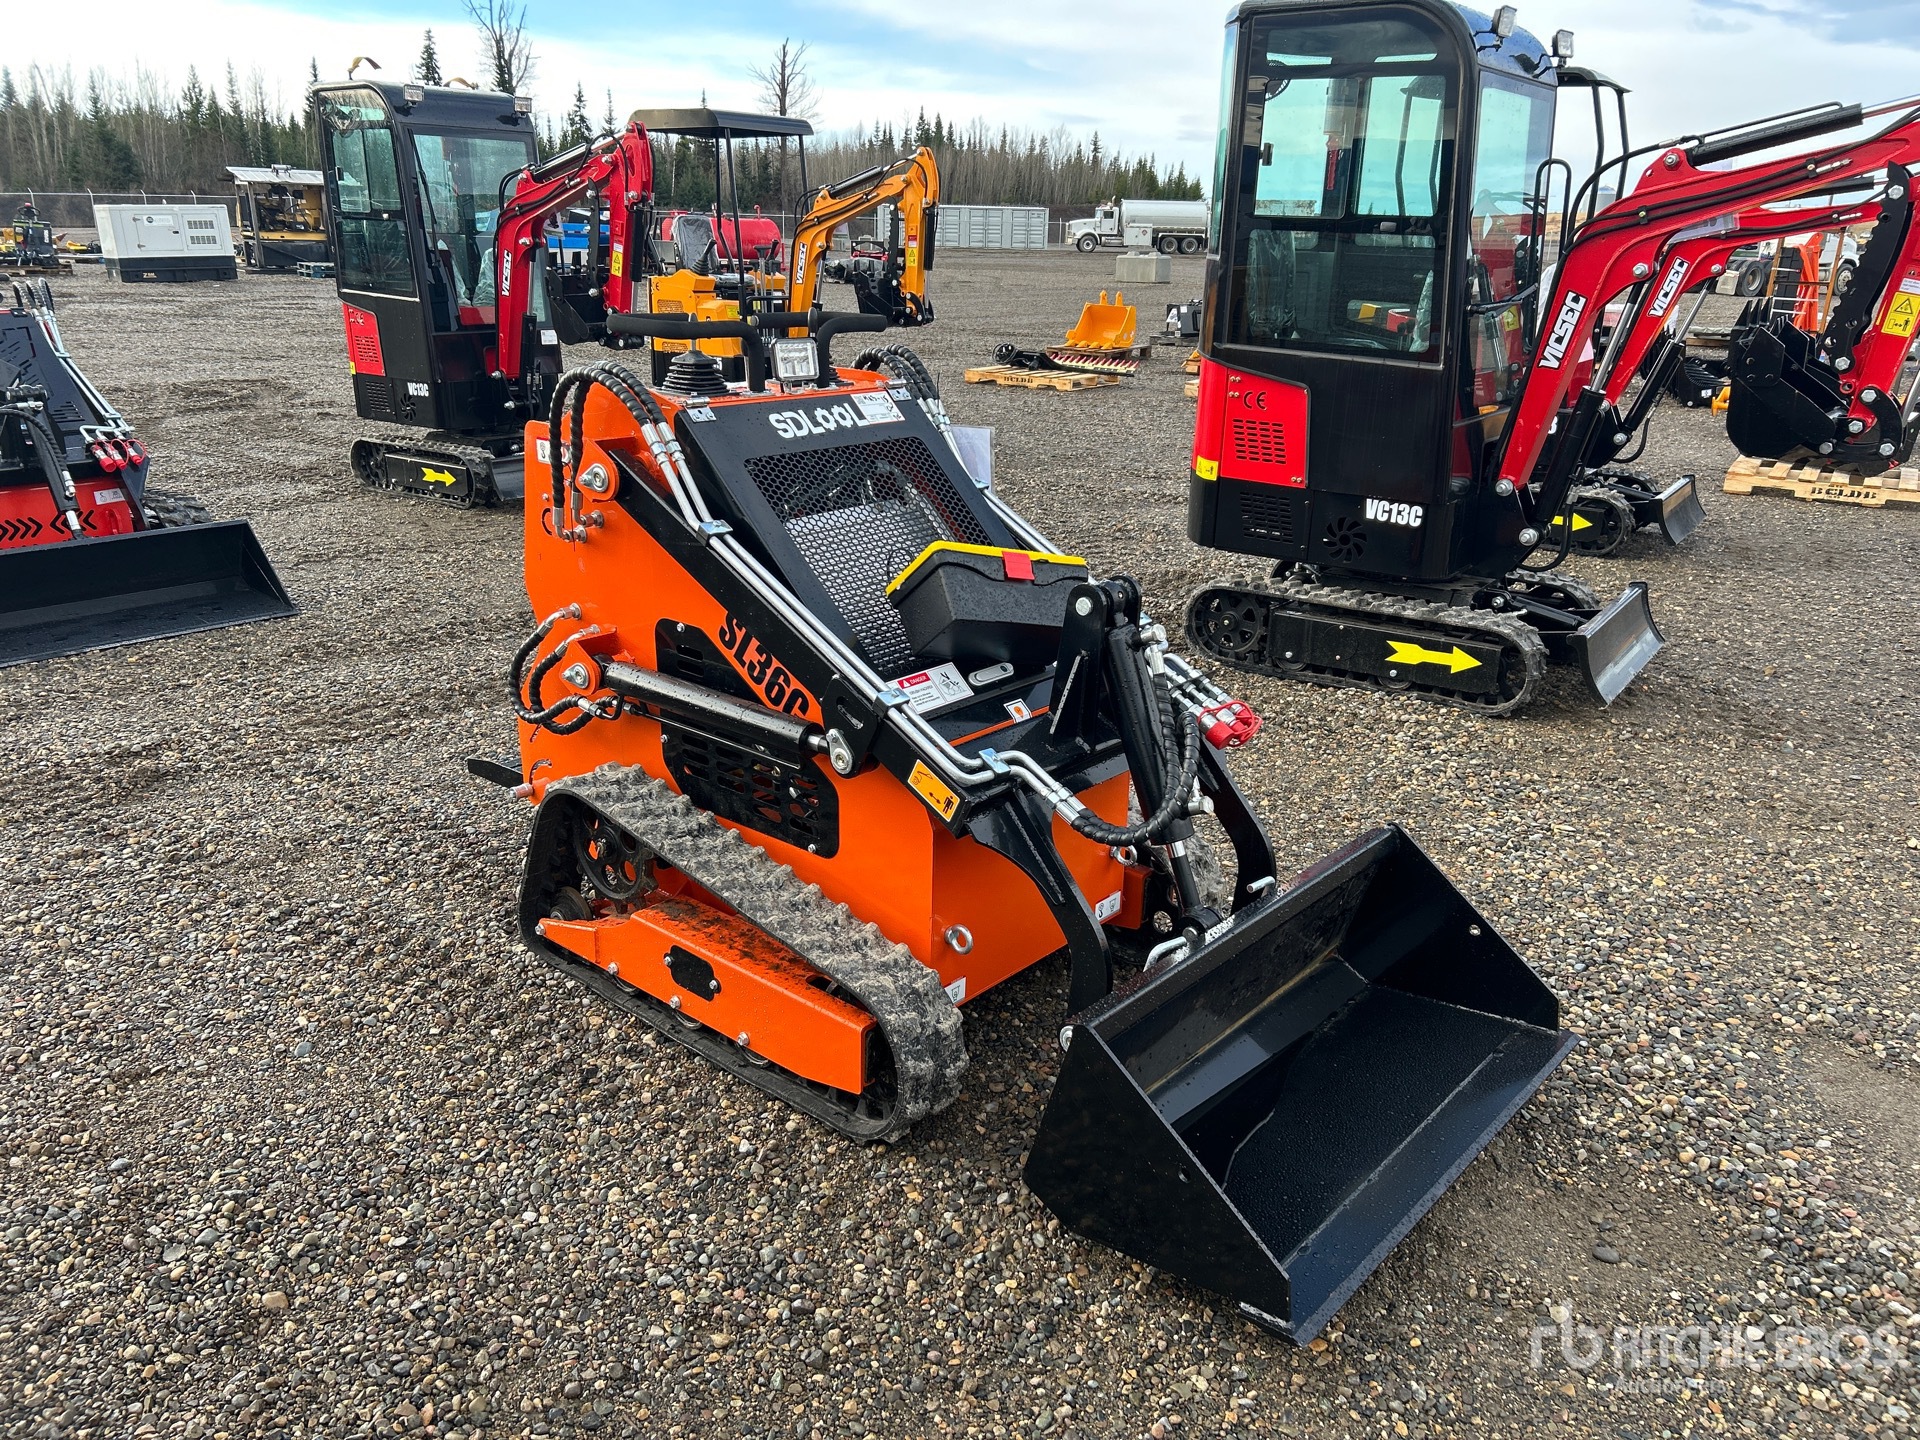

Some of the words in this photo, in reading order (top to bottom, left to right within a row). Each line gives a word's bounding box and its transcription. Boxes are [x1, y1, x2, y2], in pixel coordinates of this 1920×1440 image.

[502, 250, 512, 297] VICSEC
[1649, 257, 1690, 317] VICSEC
[1538, 291, 1586, 369] VICSEC
[407, 382, 429, 397] VC13C
[1365, 498, 1423, 527] VC13C
